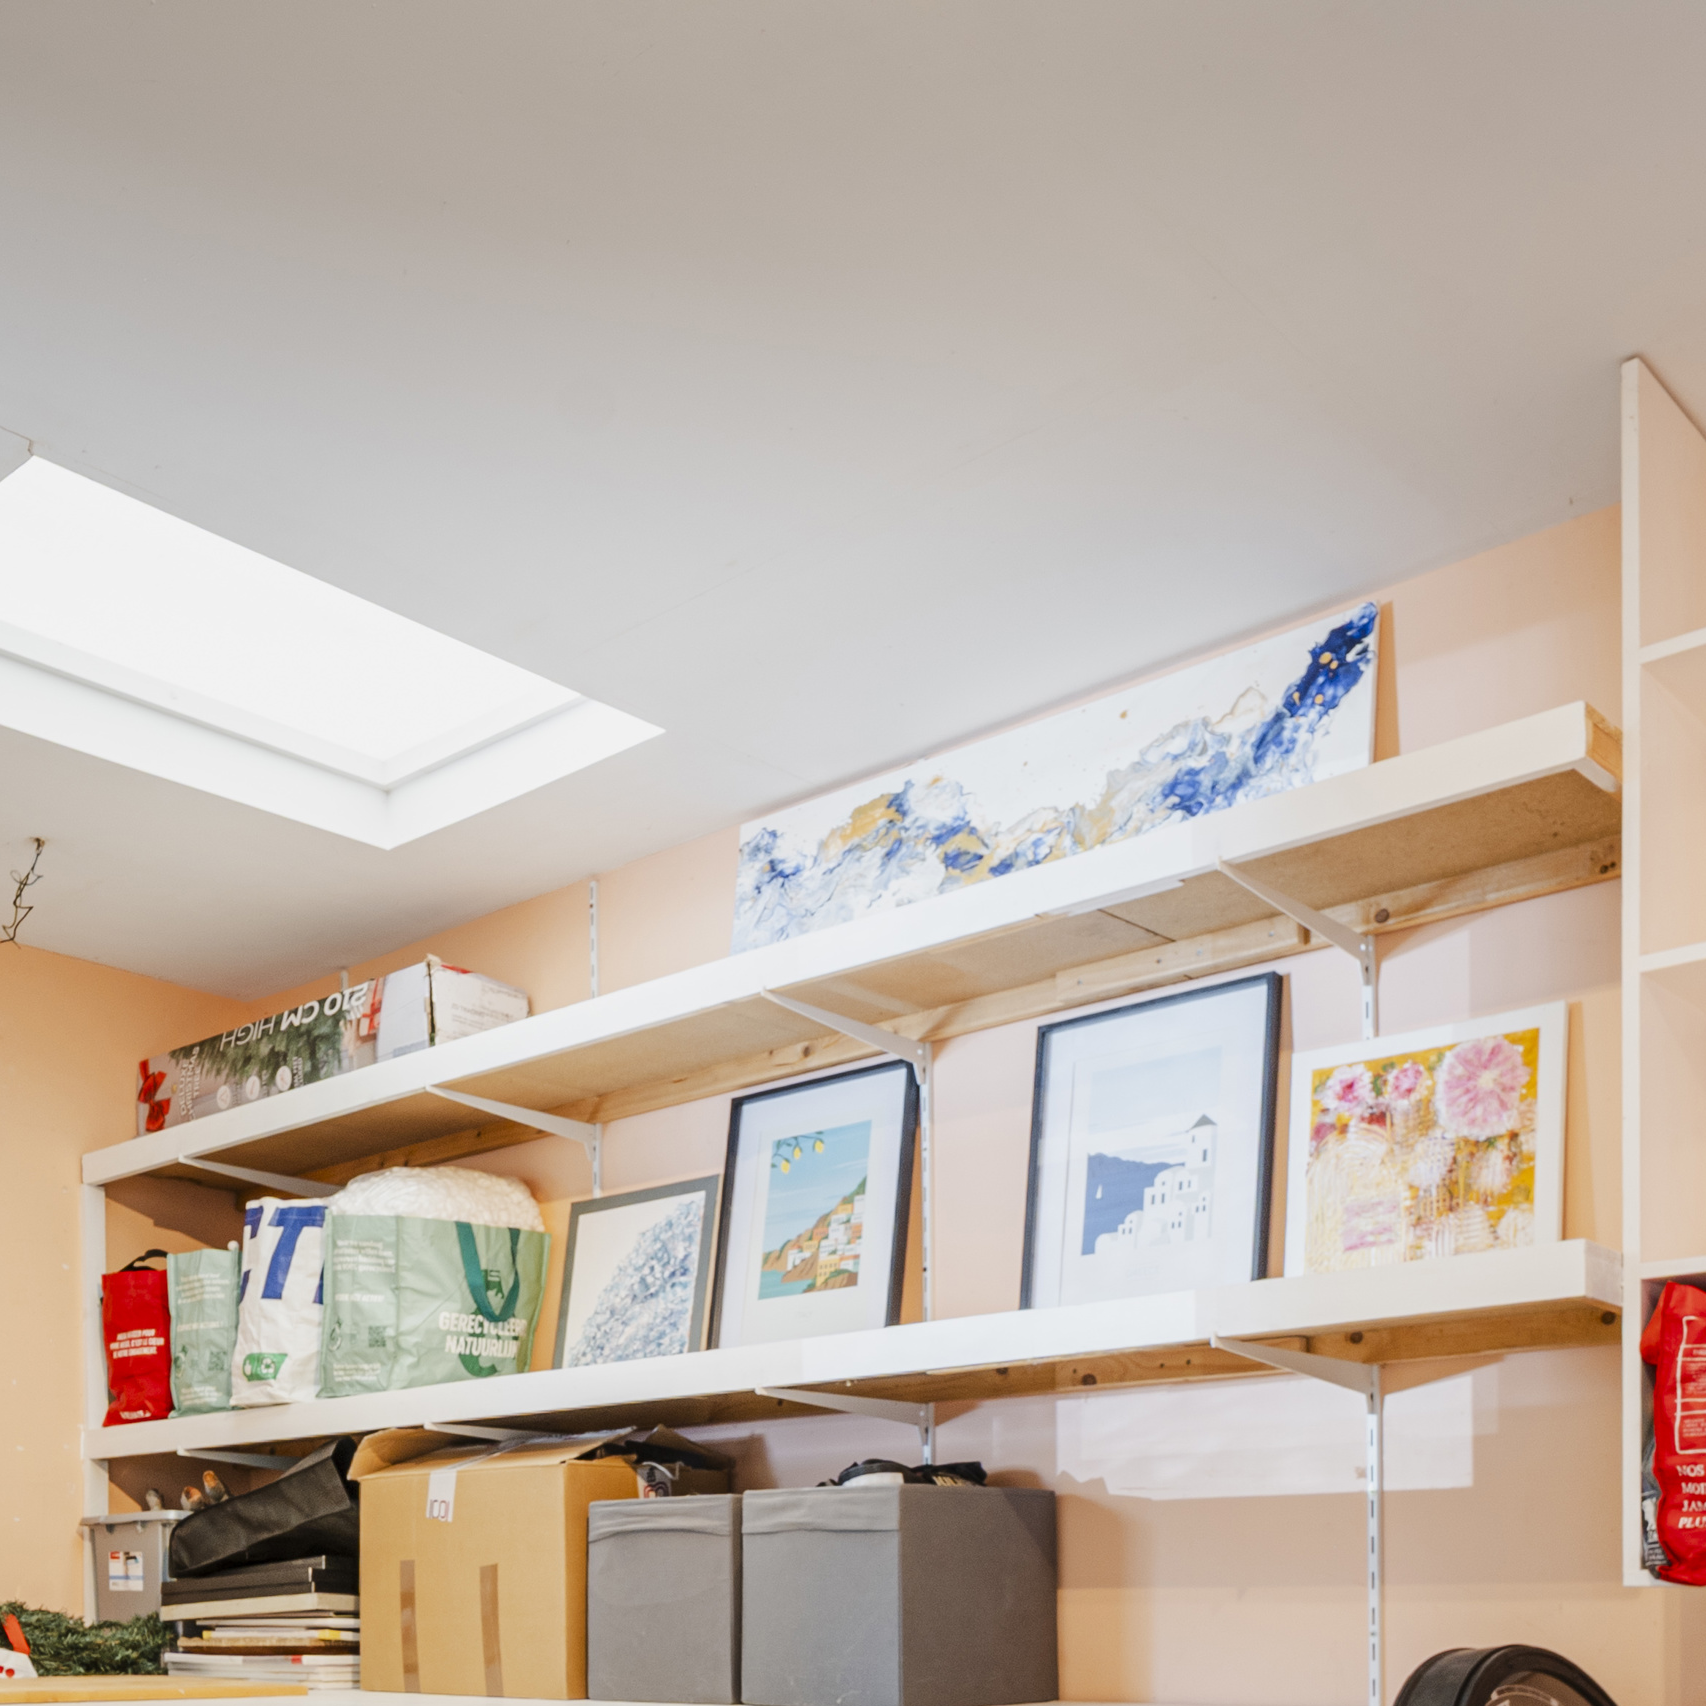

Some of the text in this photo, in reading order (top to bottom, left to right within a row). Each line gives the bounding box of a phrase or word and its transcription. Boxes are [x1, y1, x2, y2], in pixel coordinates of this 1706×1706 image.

[219, 981, 369, 1051] 210 CM HIGH
[1676, 1464, 1705, 1477] NOS
